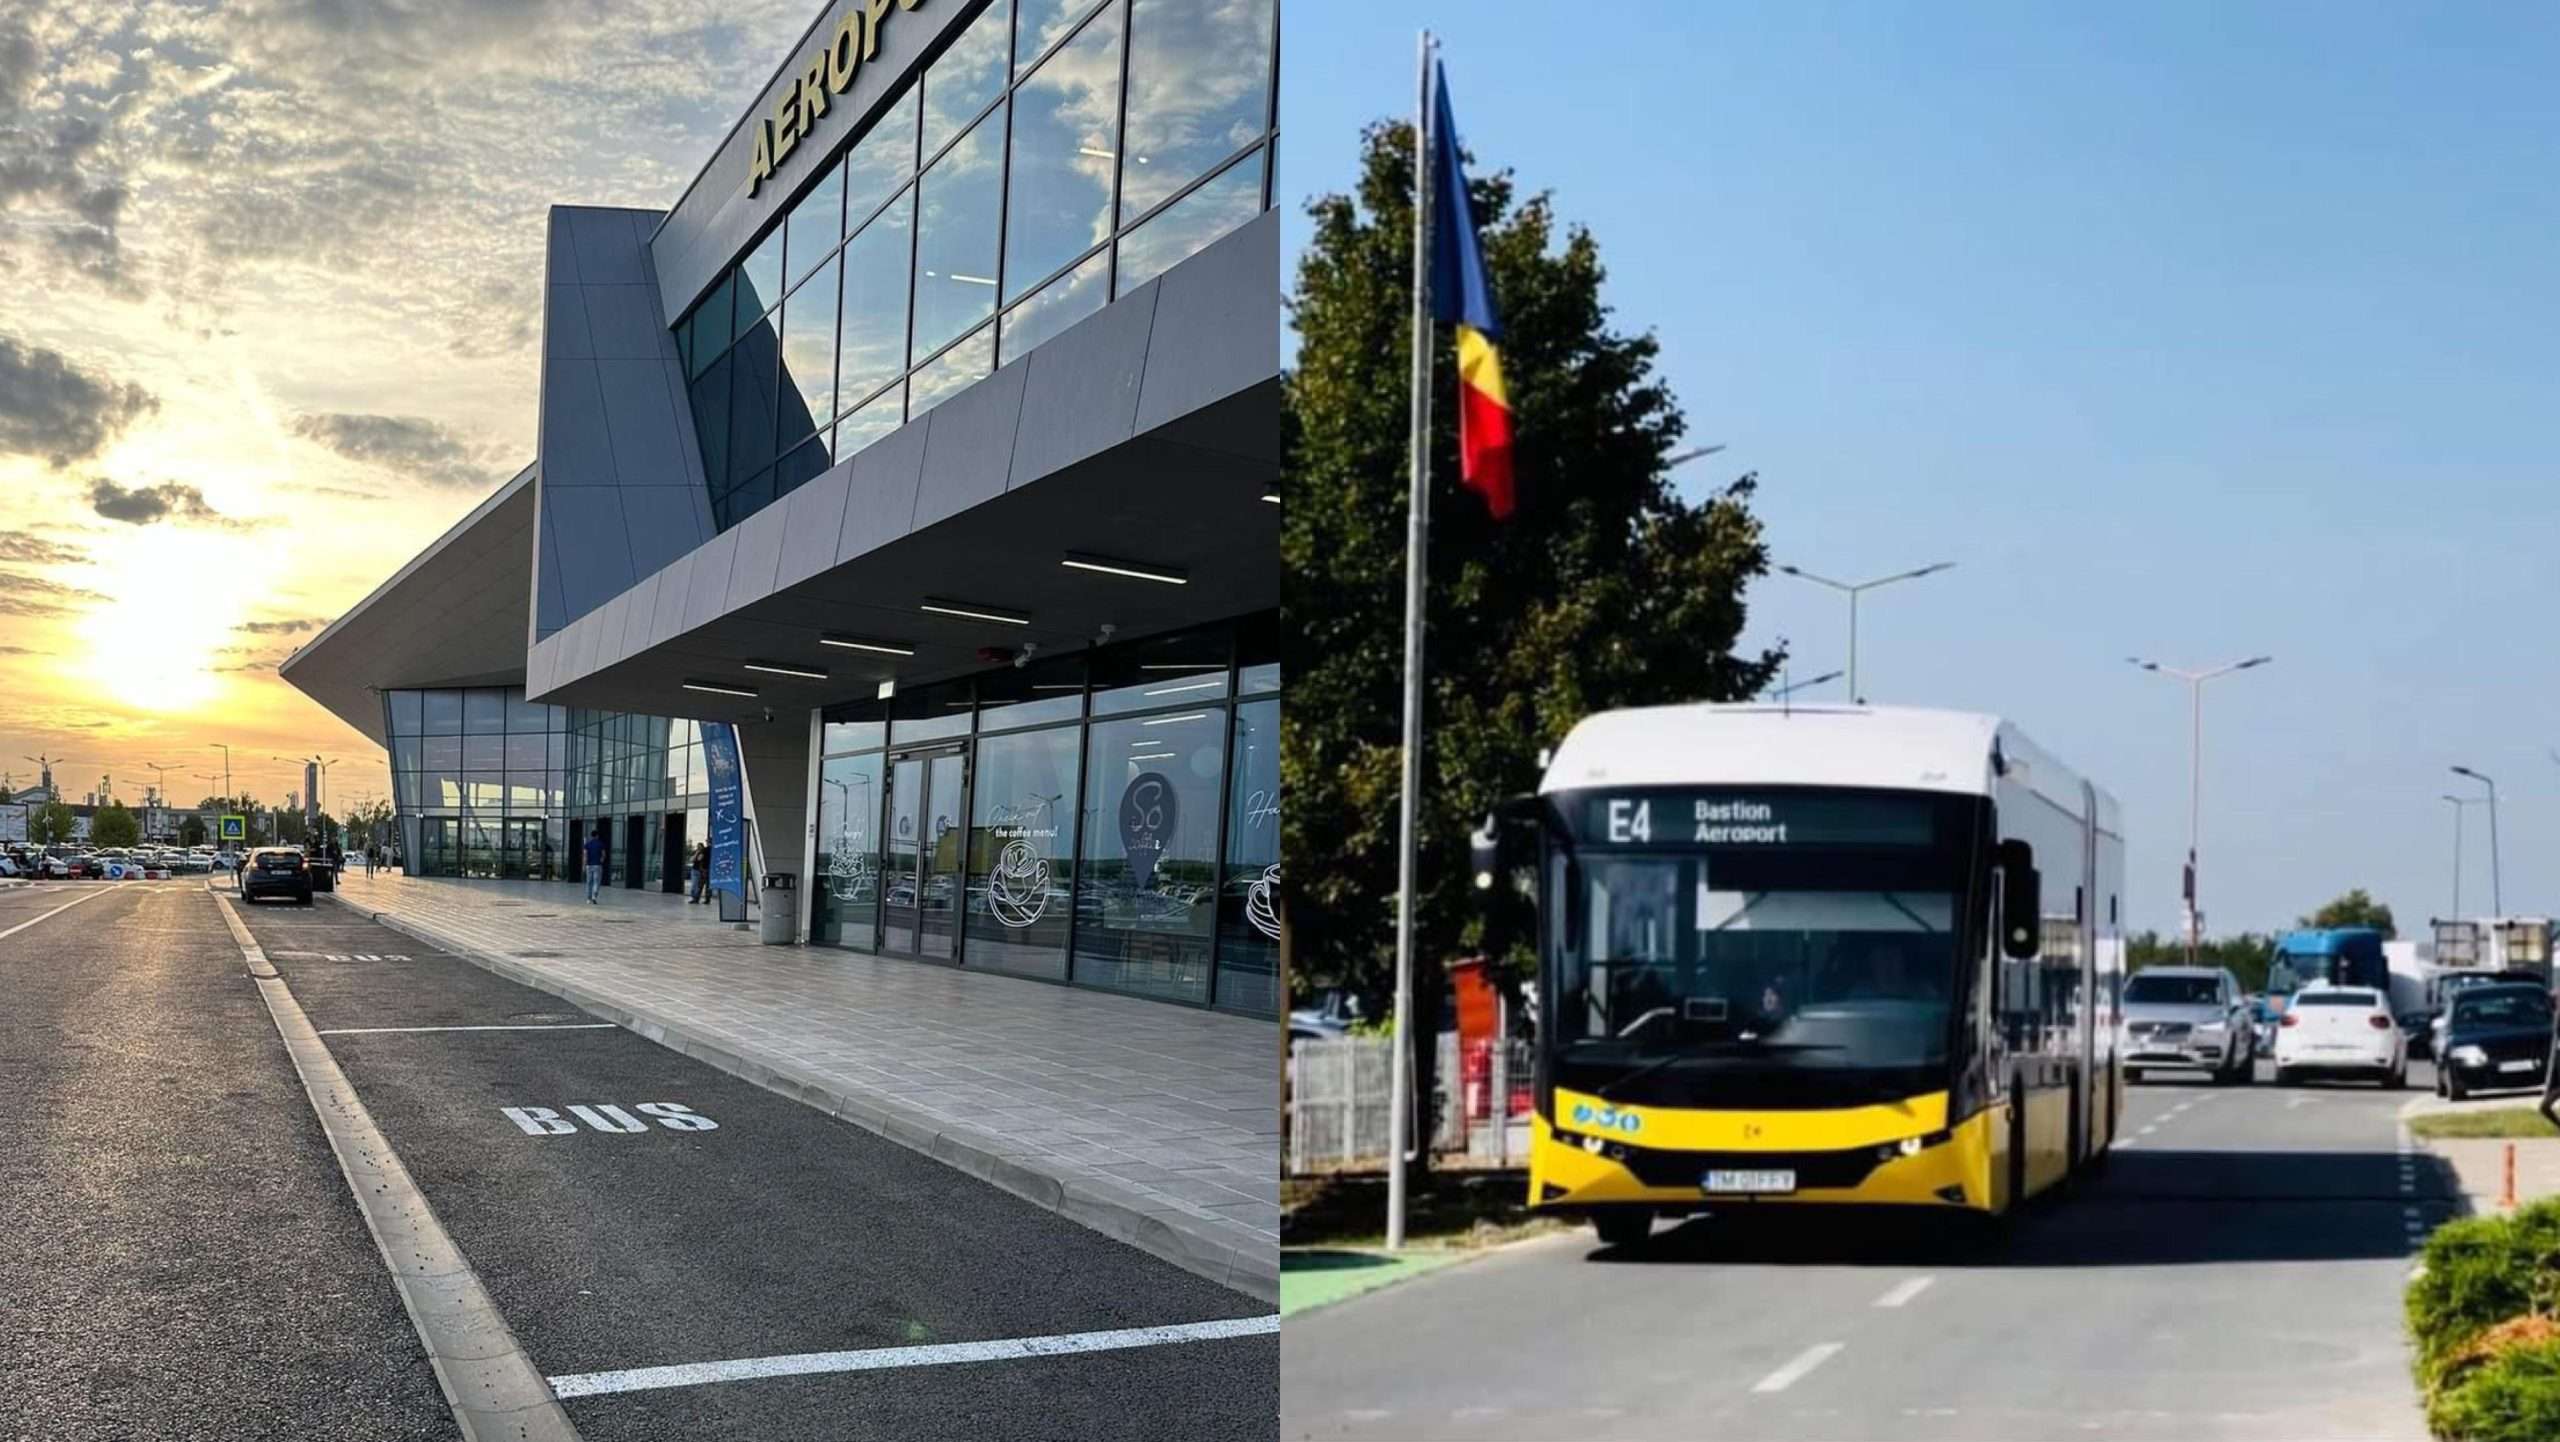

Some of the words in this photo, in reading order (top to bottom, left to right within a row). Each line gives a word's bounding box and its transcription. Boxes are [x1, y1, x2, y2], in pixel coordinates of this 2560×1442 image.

[747, 0, 928, 198] AEROP
[1608, 799, 1651, 843] E4
[1694, 800, 1772, 820] Bastion
[995, 826, 1007, 838] the
[1009, 825, 1031, 838] coffee
[1694, 823, 1787, 843] Aeroport
[500, 1102, 719, 1135] BUS
